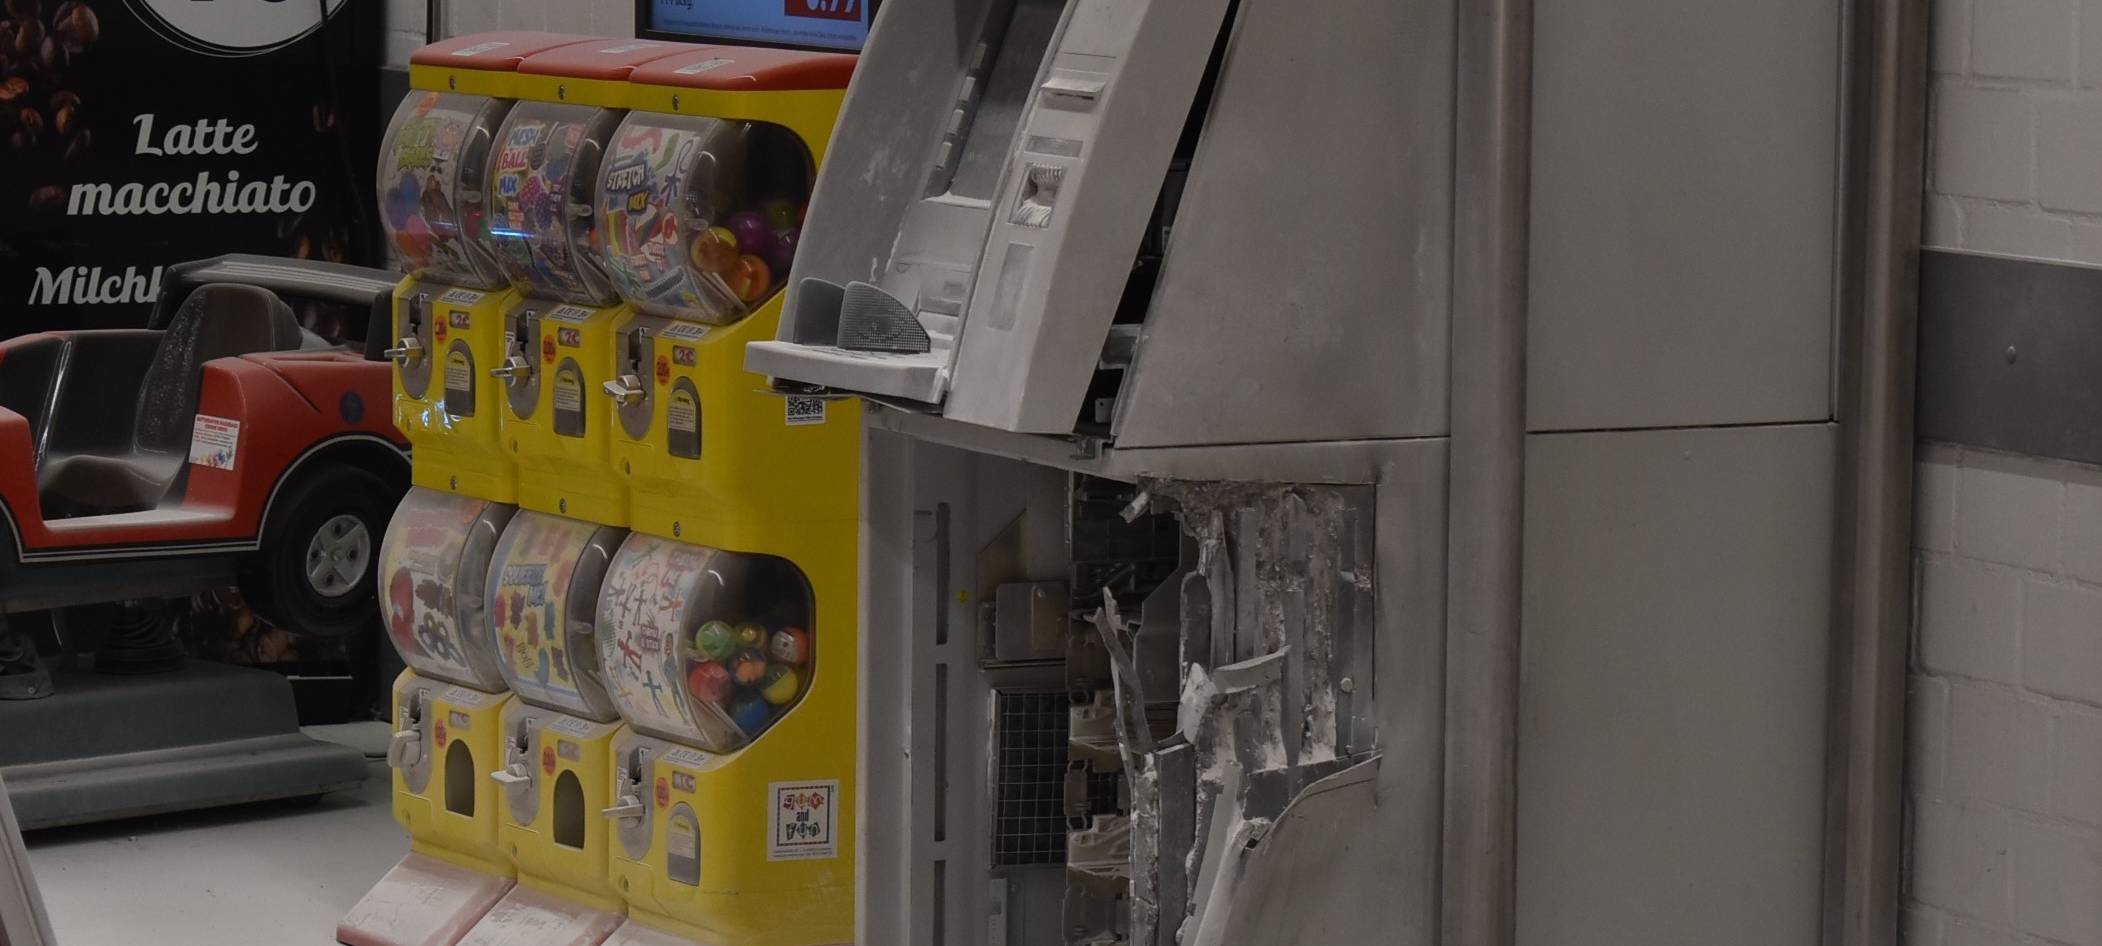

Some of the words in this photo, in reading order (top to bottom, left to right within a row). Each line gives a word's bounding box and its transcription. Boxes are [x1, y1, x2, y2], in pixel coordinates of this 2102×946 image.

[133, 113, 259, 156] Latte
[501, 150, 527, 170] BALL
[498, 175, 518, 194] MIX
[607, 164, 645, 190] STRETCH
[66, 170, 316, 216] macchiato
[628, 191, 649, 212] MIX
[796, 809, 809, 822] and
